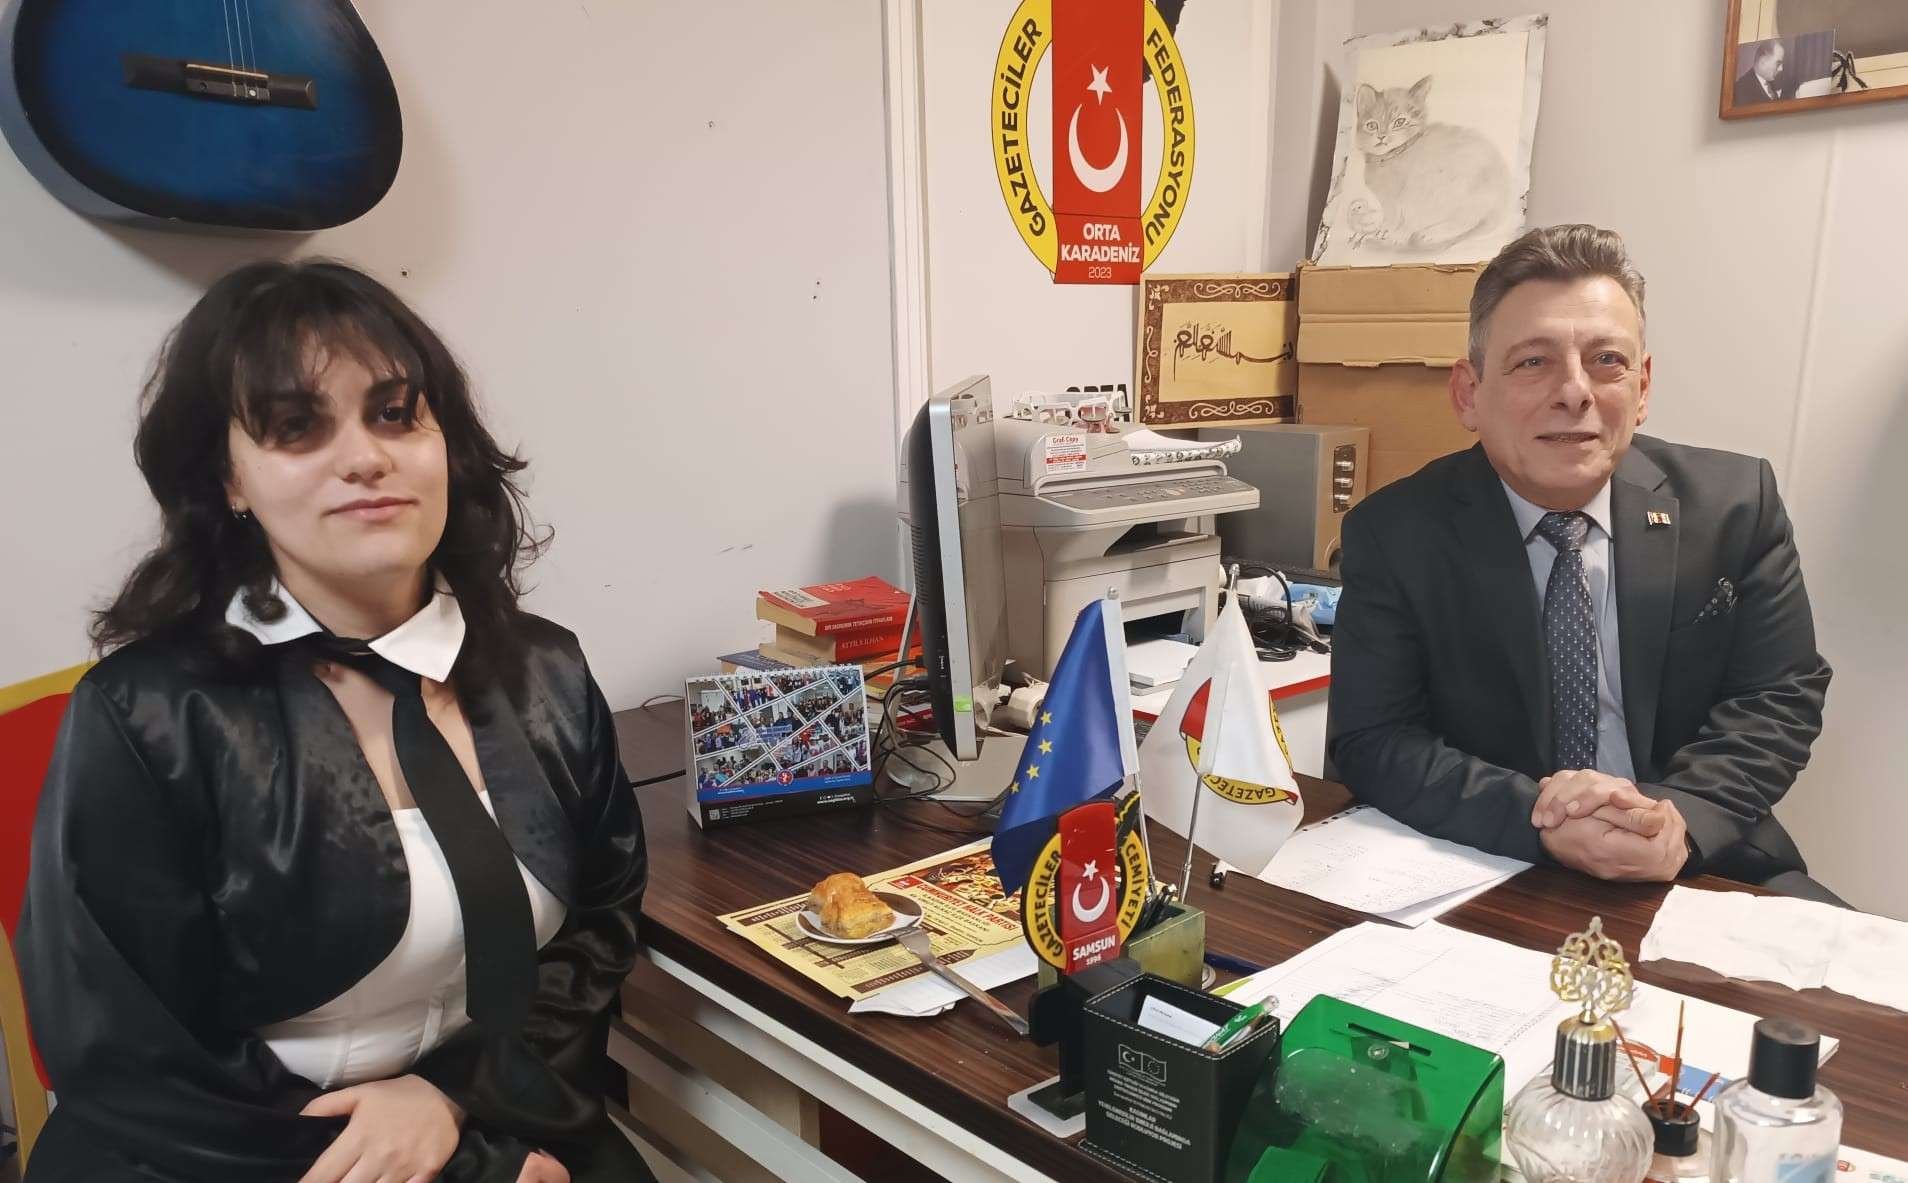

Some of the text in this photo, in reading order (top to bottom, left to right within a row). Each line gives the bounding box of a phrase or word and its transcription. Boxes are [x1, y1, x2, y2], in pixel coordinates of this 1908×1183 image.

[1001, 18, 1046, 236] GAZETECİLER
[1145, 28, 1185, 245] FEDERASYONU
[1083, 222, 1121, 241] ORTA
[1061, 242, 1140, 263] KARADENİZ
[1088, 266, 1112, 279] 2023
[1072, 935, 1116, 961] SAMSUN
